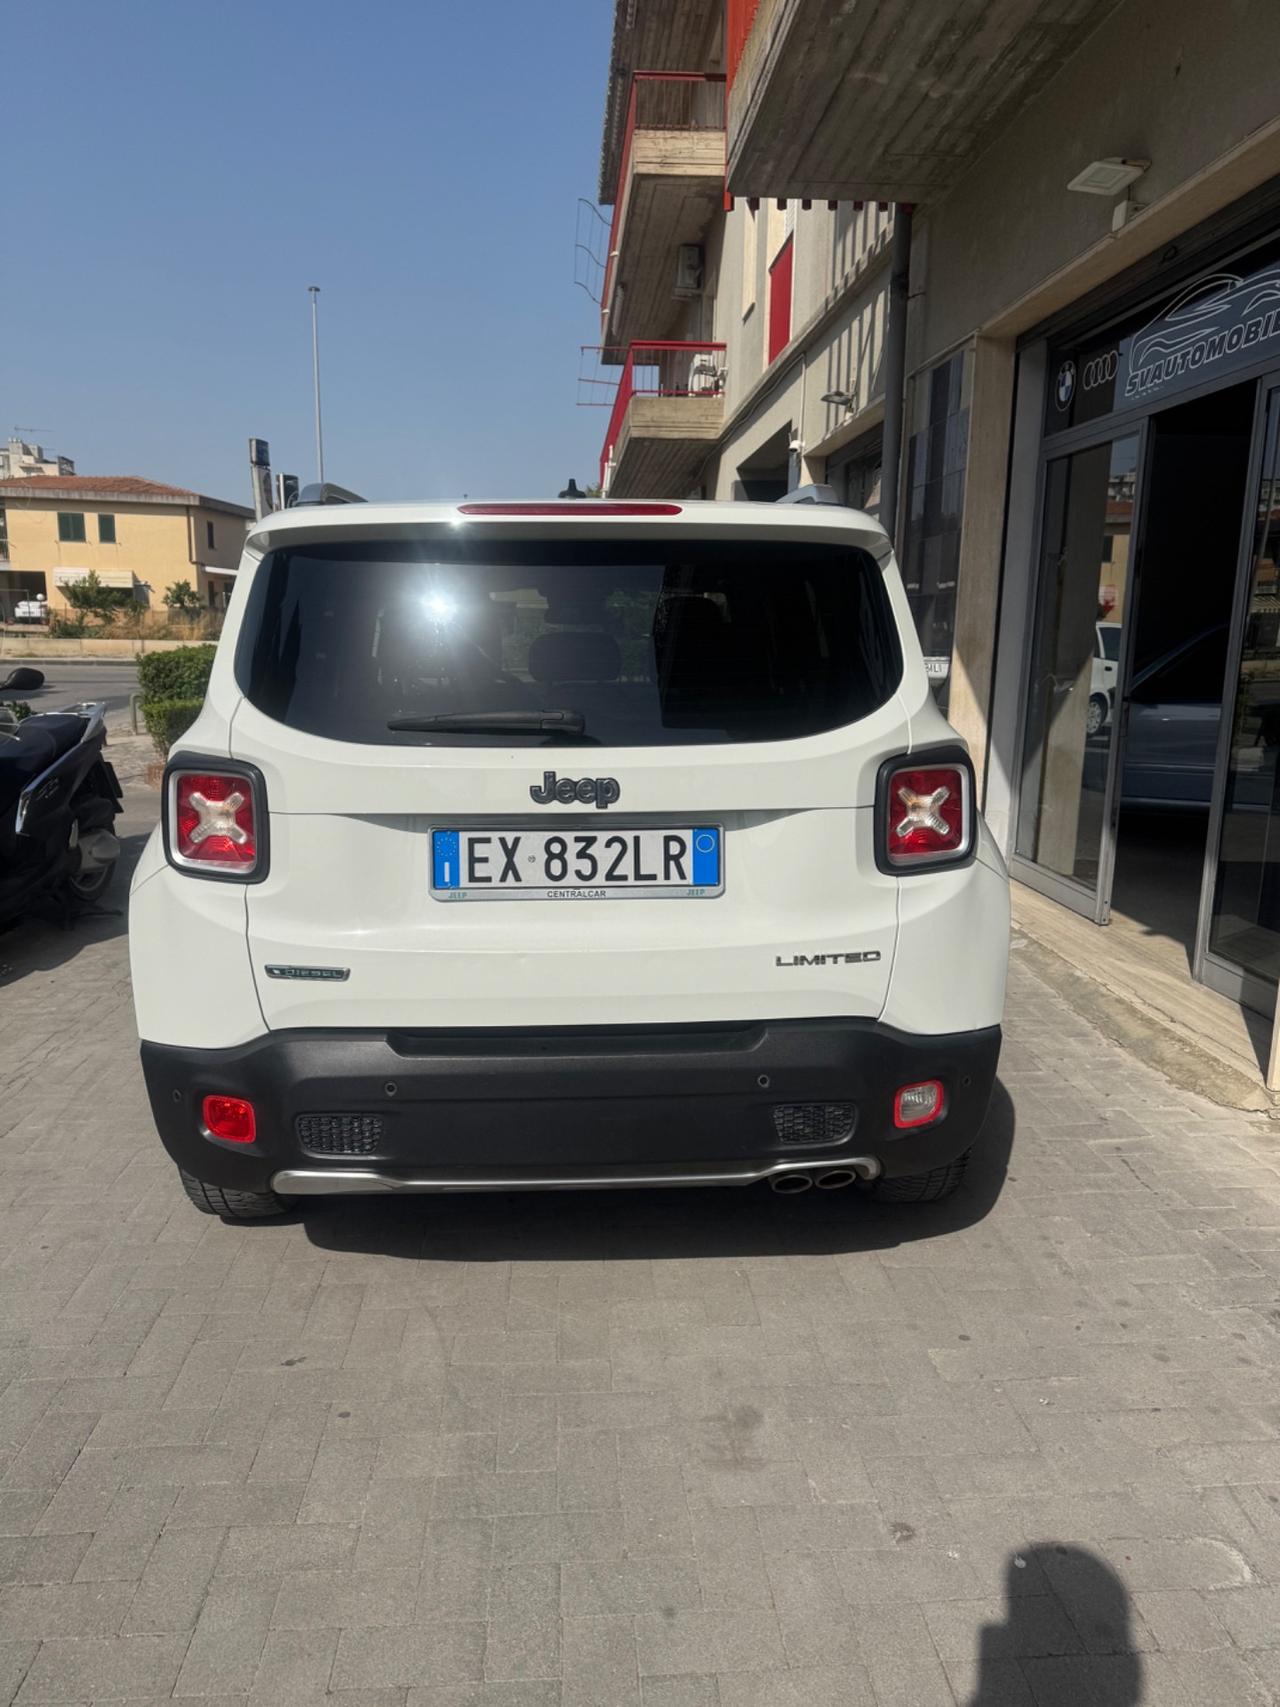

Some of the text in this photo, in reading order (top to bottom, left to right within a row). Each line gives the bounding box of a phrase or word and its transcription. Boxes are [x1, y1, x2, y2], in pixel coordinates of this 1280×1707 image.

[530, 771, 620, 809] Jeep
[467, 836, 523, 883] EX
[544, 834, 687, 882] 832LR
[547, 889, 607, 898] CENTRALCAR
[776, 950, 881, 967] LIMITED
